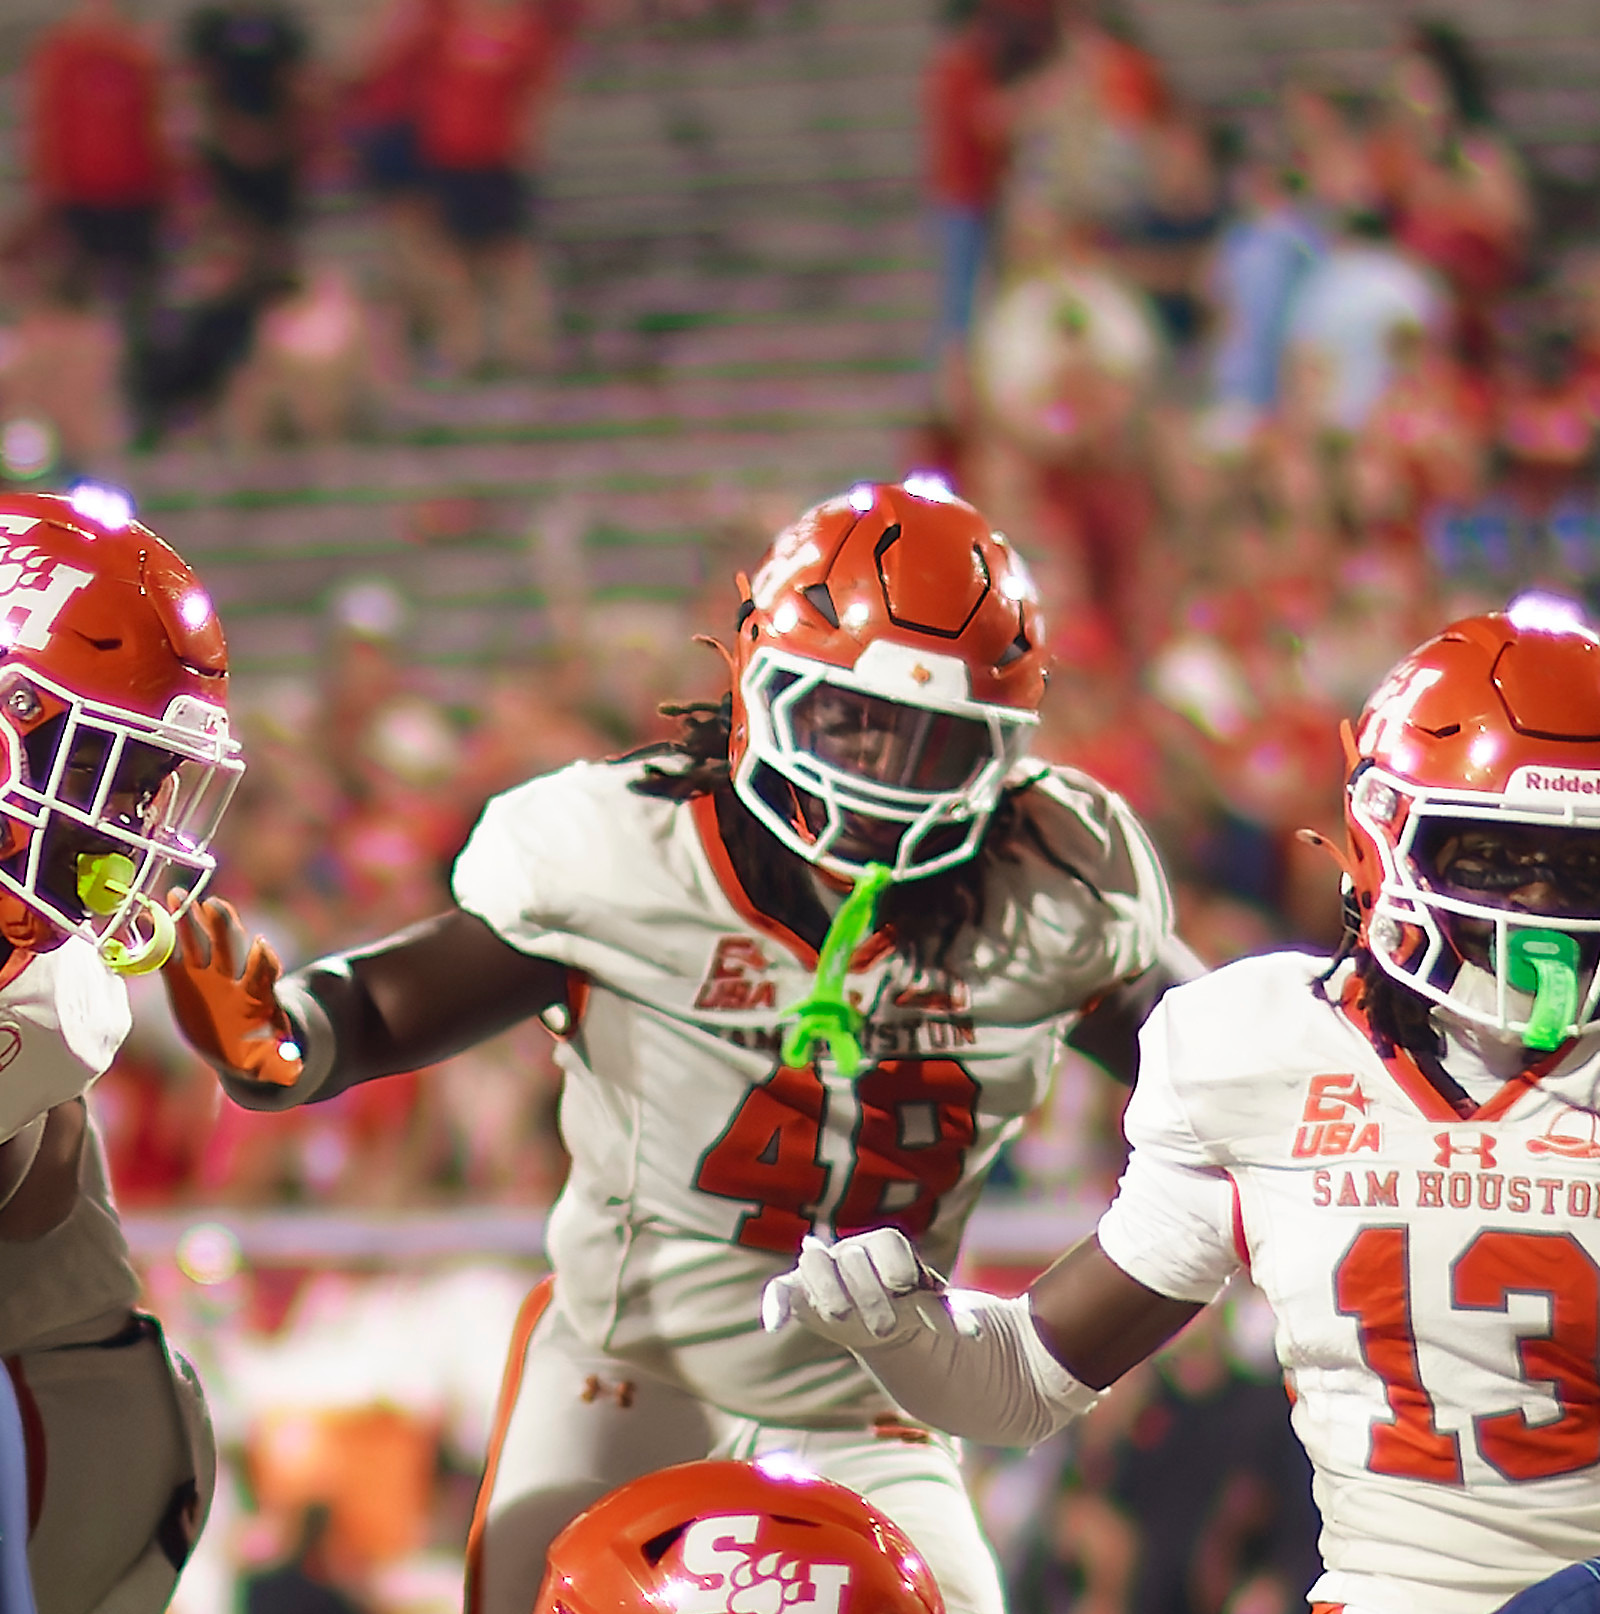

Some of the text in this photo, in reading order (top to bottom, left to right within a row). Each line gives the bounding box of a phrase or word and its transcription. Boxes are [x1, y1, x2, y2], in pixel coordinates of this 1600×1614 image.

[690, 1059, 983, 1253] 48
[1291, 1122, 1382, 1159] USA
[1313, 1170, 1401, 1208] SAM
